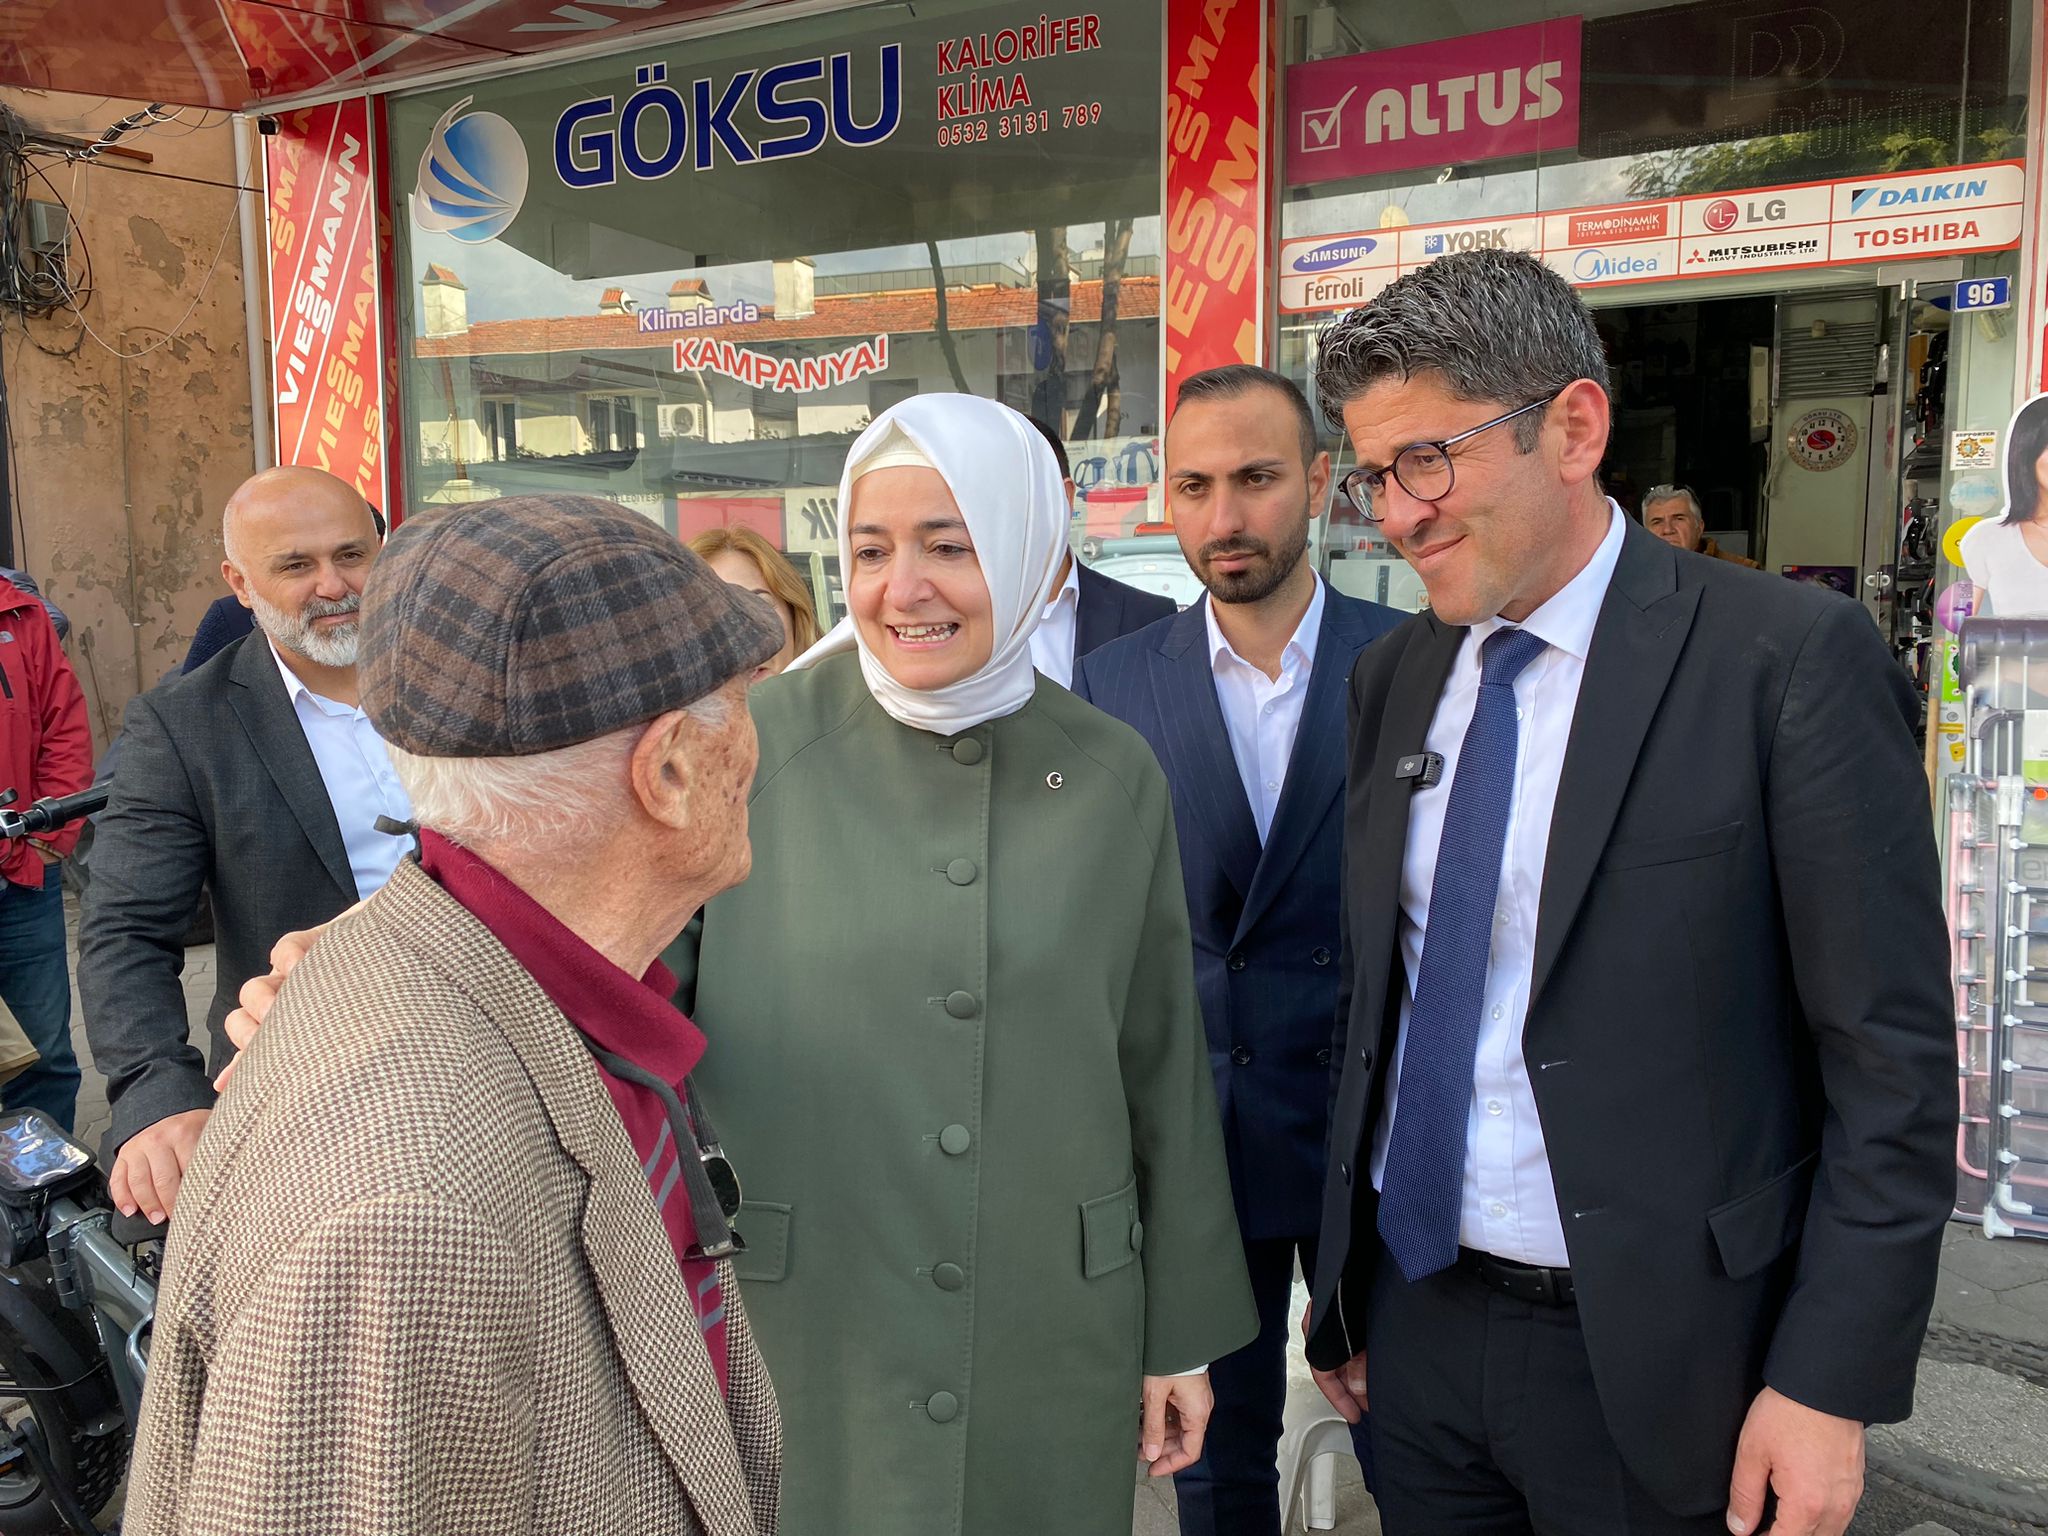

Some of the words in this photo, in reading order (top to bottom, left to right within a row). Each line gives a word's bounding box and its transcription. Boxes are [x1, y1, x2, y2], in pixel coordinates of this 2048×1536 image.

[937, 14, 1102, 76] KALORİFER
[937, 72, 1032, 121] KLİMA
[1365, 61, 1563, 145] ALTUS
[553, 43, 902, 190] GÖKSU
[938, 120, 988, 147] 0532
[999, 110, 1049, 138] 3131
[1062, 101, 1102, 129] 789
[1878, 180, 1988, 207] DAIKIN
[1576, 212, 1660, 232] TERMODİNAMİK
[1746, 199, 1787, 223] LG
[1444, 228, 1508, 253] YORK
[1708, 240, 1818, 257] MITSUBISHI
[1854, 221, 1980, 248] TOSHIBA
[278, 131, 361, 405] VIESSMANN
[1303, 246, 1367, 263] SAMSUNG
[1586, 255, 1658, 279] Midea
[1304, 277, 1364, 306] Ferroli
[1967, 282, 1996, 306] 96
[638, 301, 758, 332] Klimalarda
[674, 335, 887, 391] KAMPANYA!
